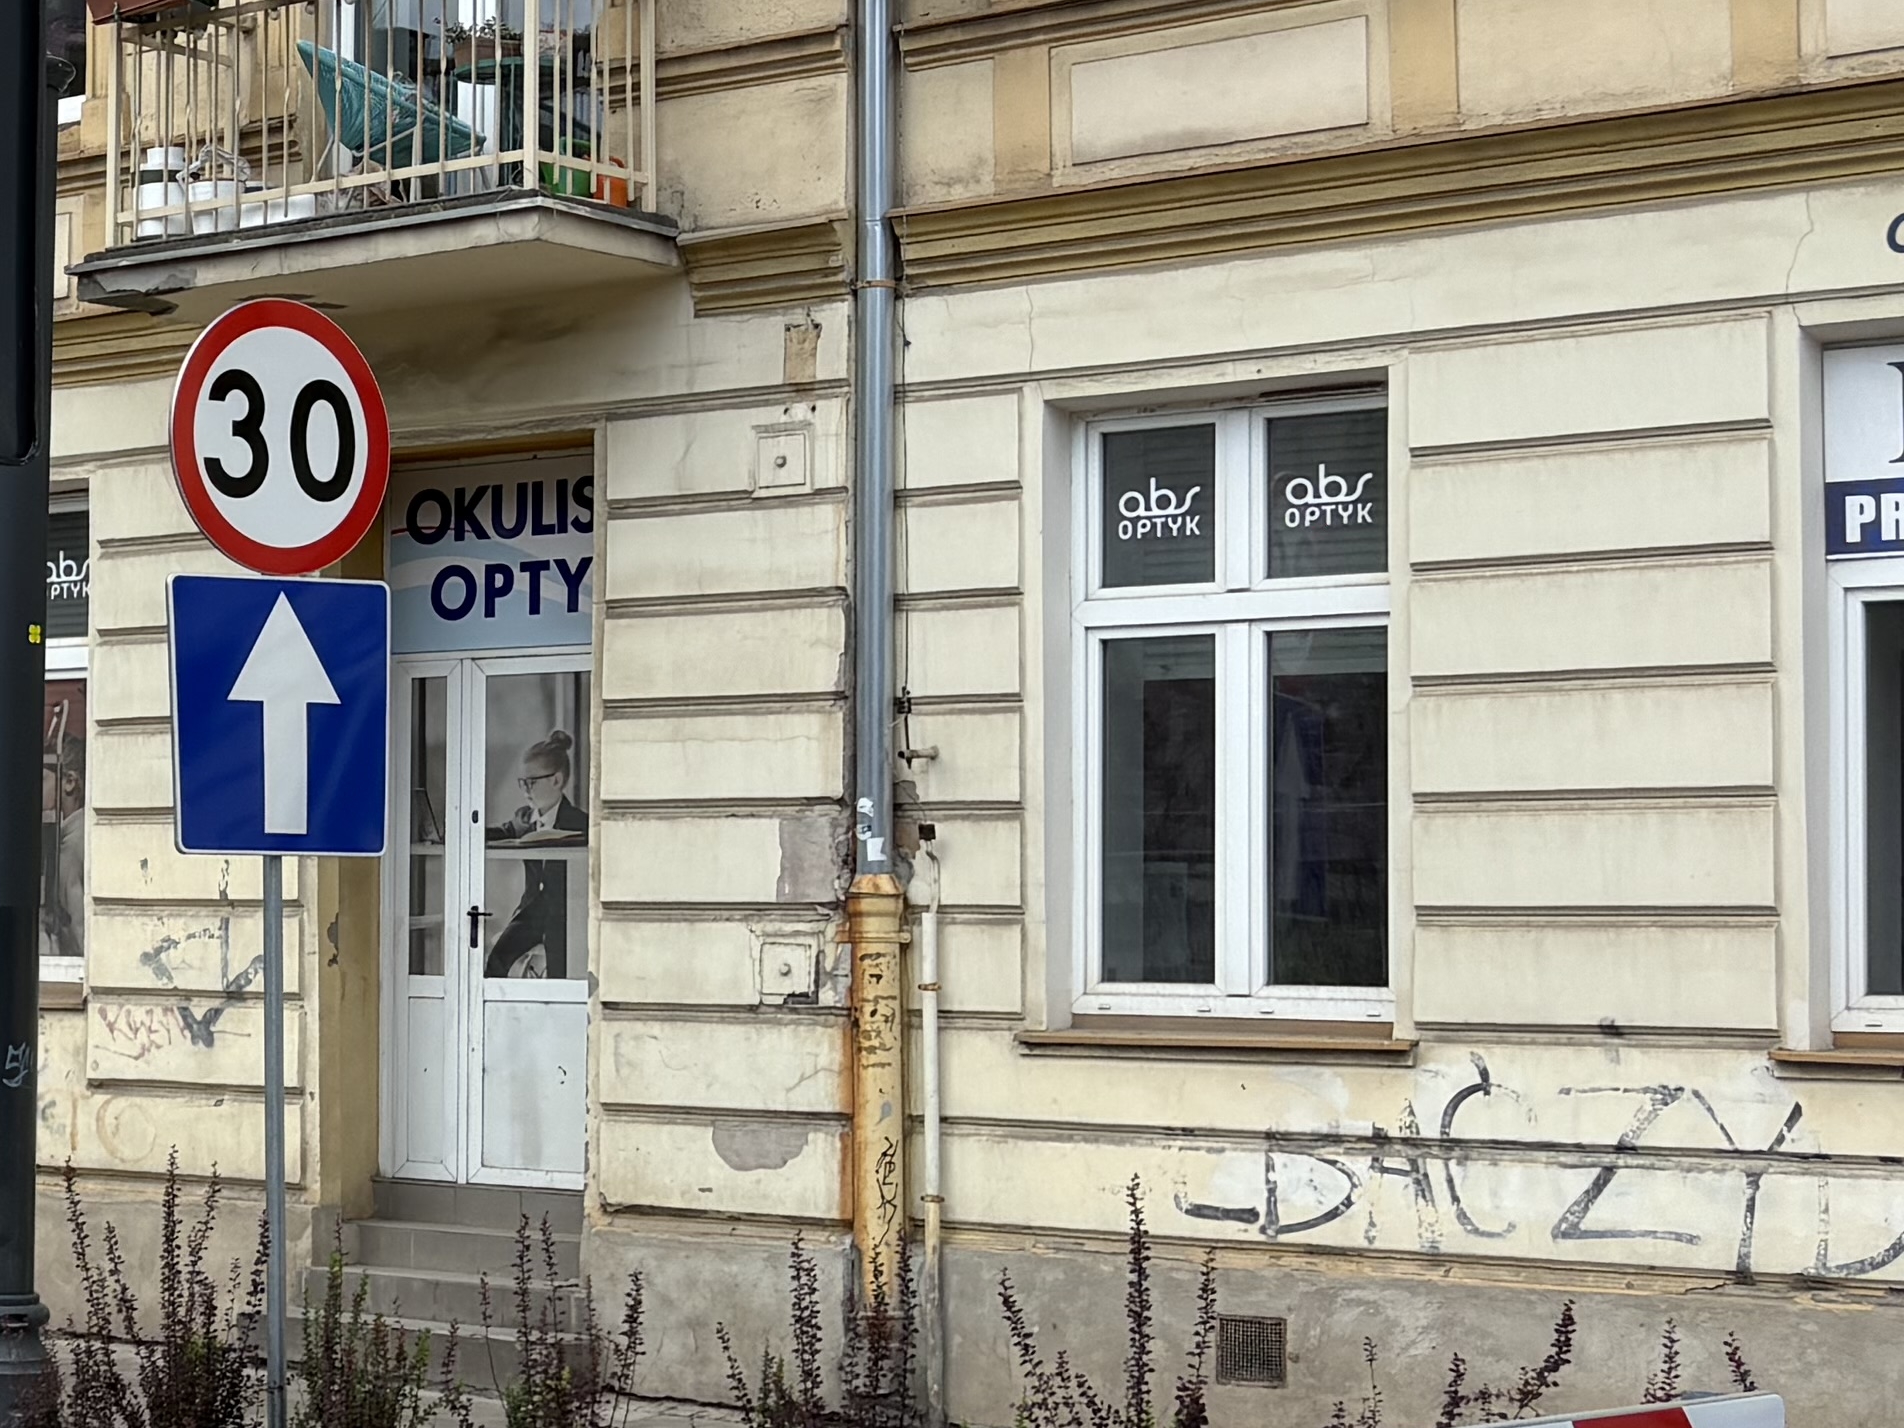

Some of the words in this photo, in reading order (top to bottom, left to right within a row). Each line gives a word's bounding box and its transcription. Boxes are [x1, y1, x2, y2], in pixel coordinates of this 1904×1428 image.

[204, 369, 356, 503] 30
[1118, 477, 1201, 518] abs
[1285, 463, 1373, 505] abs
[406, 475, 594, 545] OKULIS
[1118, 515, 1201, 540] OPTYK
[1285, 502, 1373, 528] OPTYK
[50, 582, 90, 600] PTYK
[430, 556, 594, 622] OPTY
